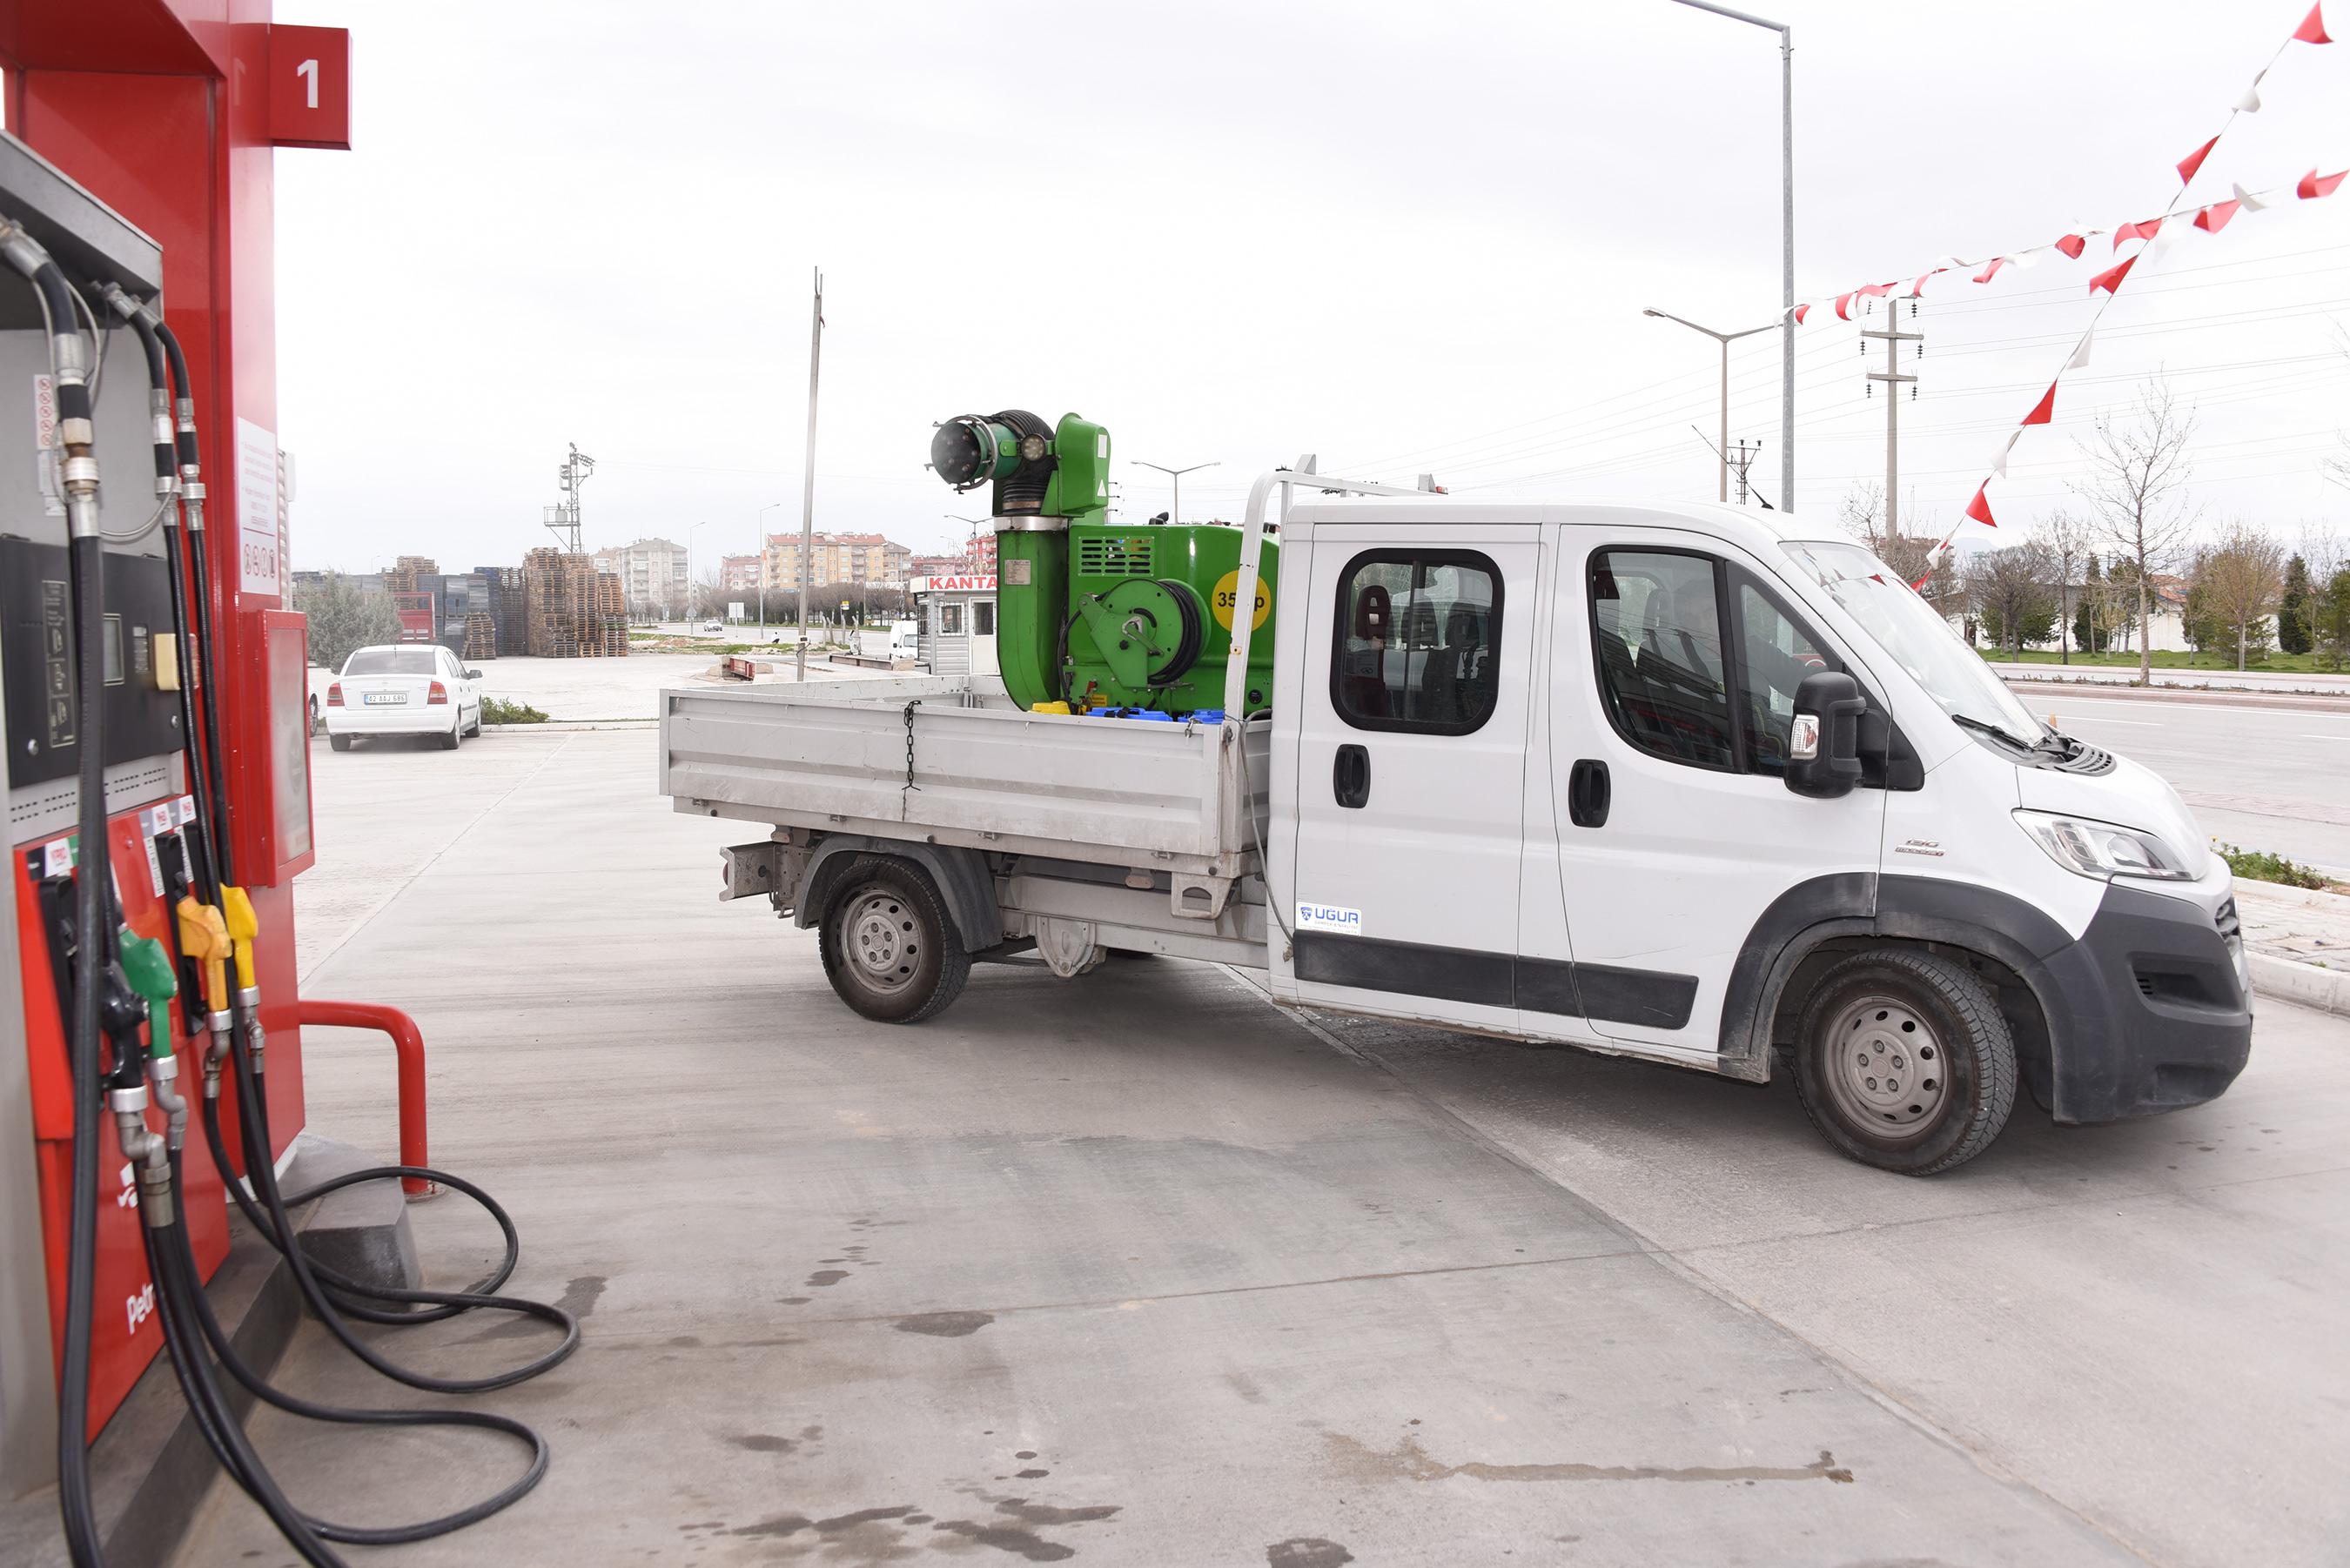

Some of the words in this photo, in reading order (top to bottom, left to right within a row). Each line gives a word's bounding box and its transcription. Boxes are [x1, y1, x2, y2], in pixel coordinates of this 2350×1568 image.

[298, 59, 319, 108] 1
[1315, 908, 1358, 924] UĞUR
[126, 1283, 157, 1335] Petr
